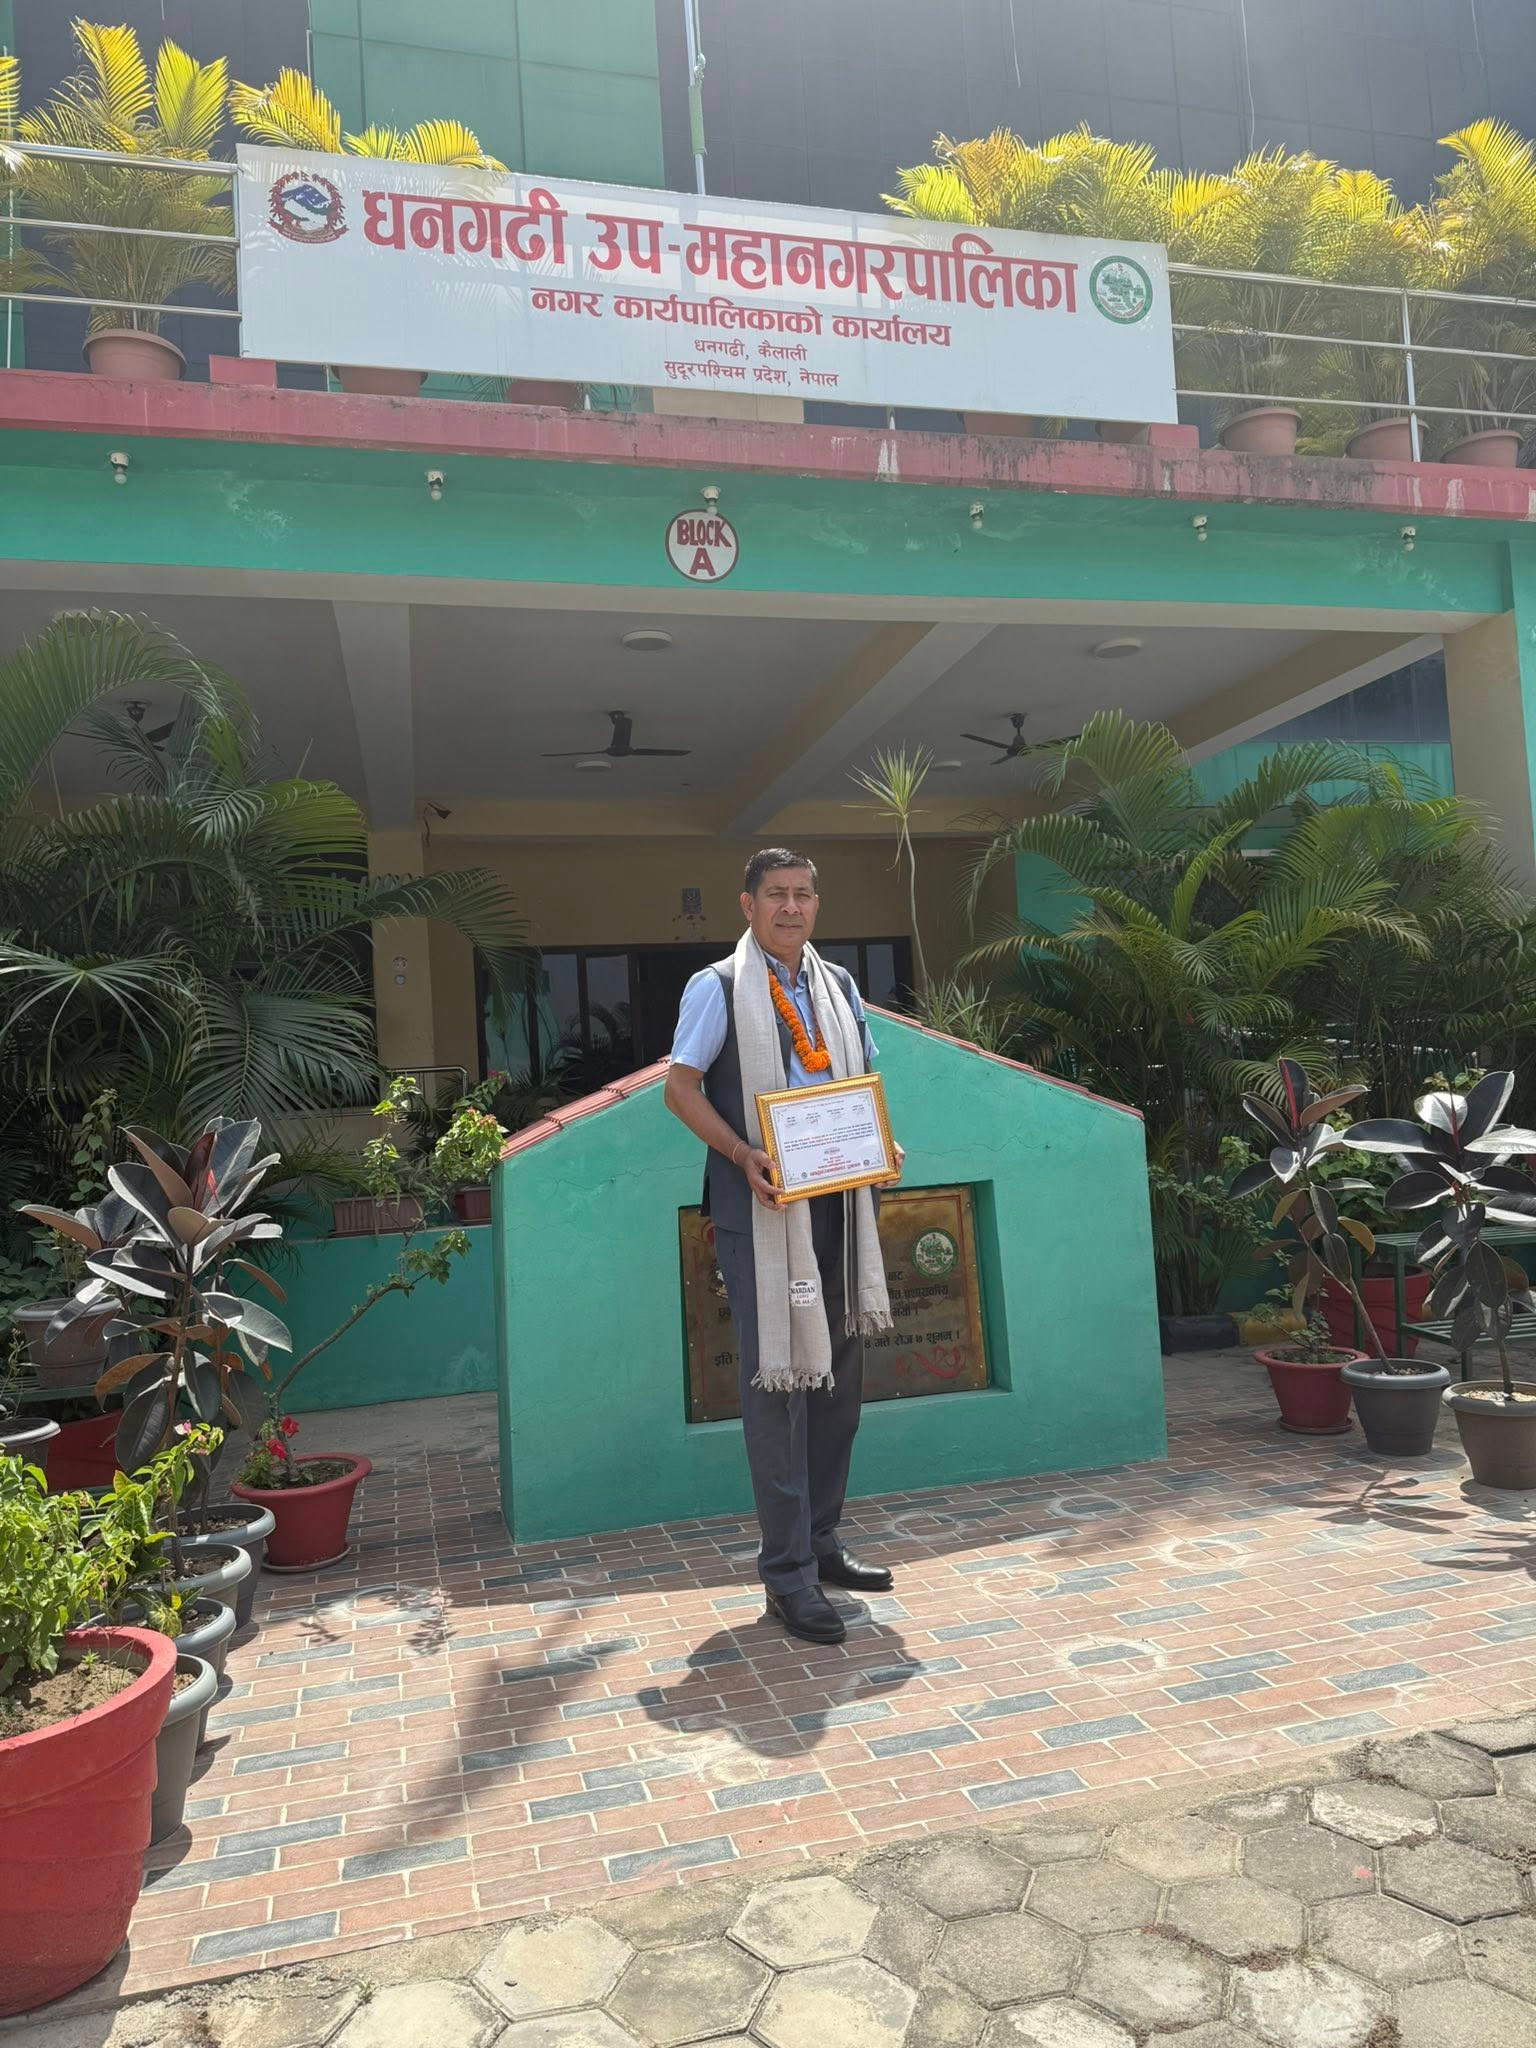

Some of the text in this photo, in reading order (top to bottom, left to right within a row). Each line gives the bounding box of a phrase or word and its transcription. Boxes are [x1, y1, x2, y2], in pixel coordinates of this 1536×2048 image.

[362, 187, 568, 264] धनगढी
[585, 212, 1078, 313] उप-महानगरपालिका
[530, 287, 952, 347] नगर कार्यपालिकाको कार्यालय
[694, 338, 807, 362] धनगढी, कैलाली
[799, 367, 839, 387] नेपाल
[676, 518, 732, 548] BLOCK
[689, 547, 716, 577] A
